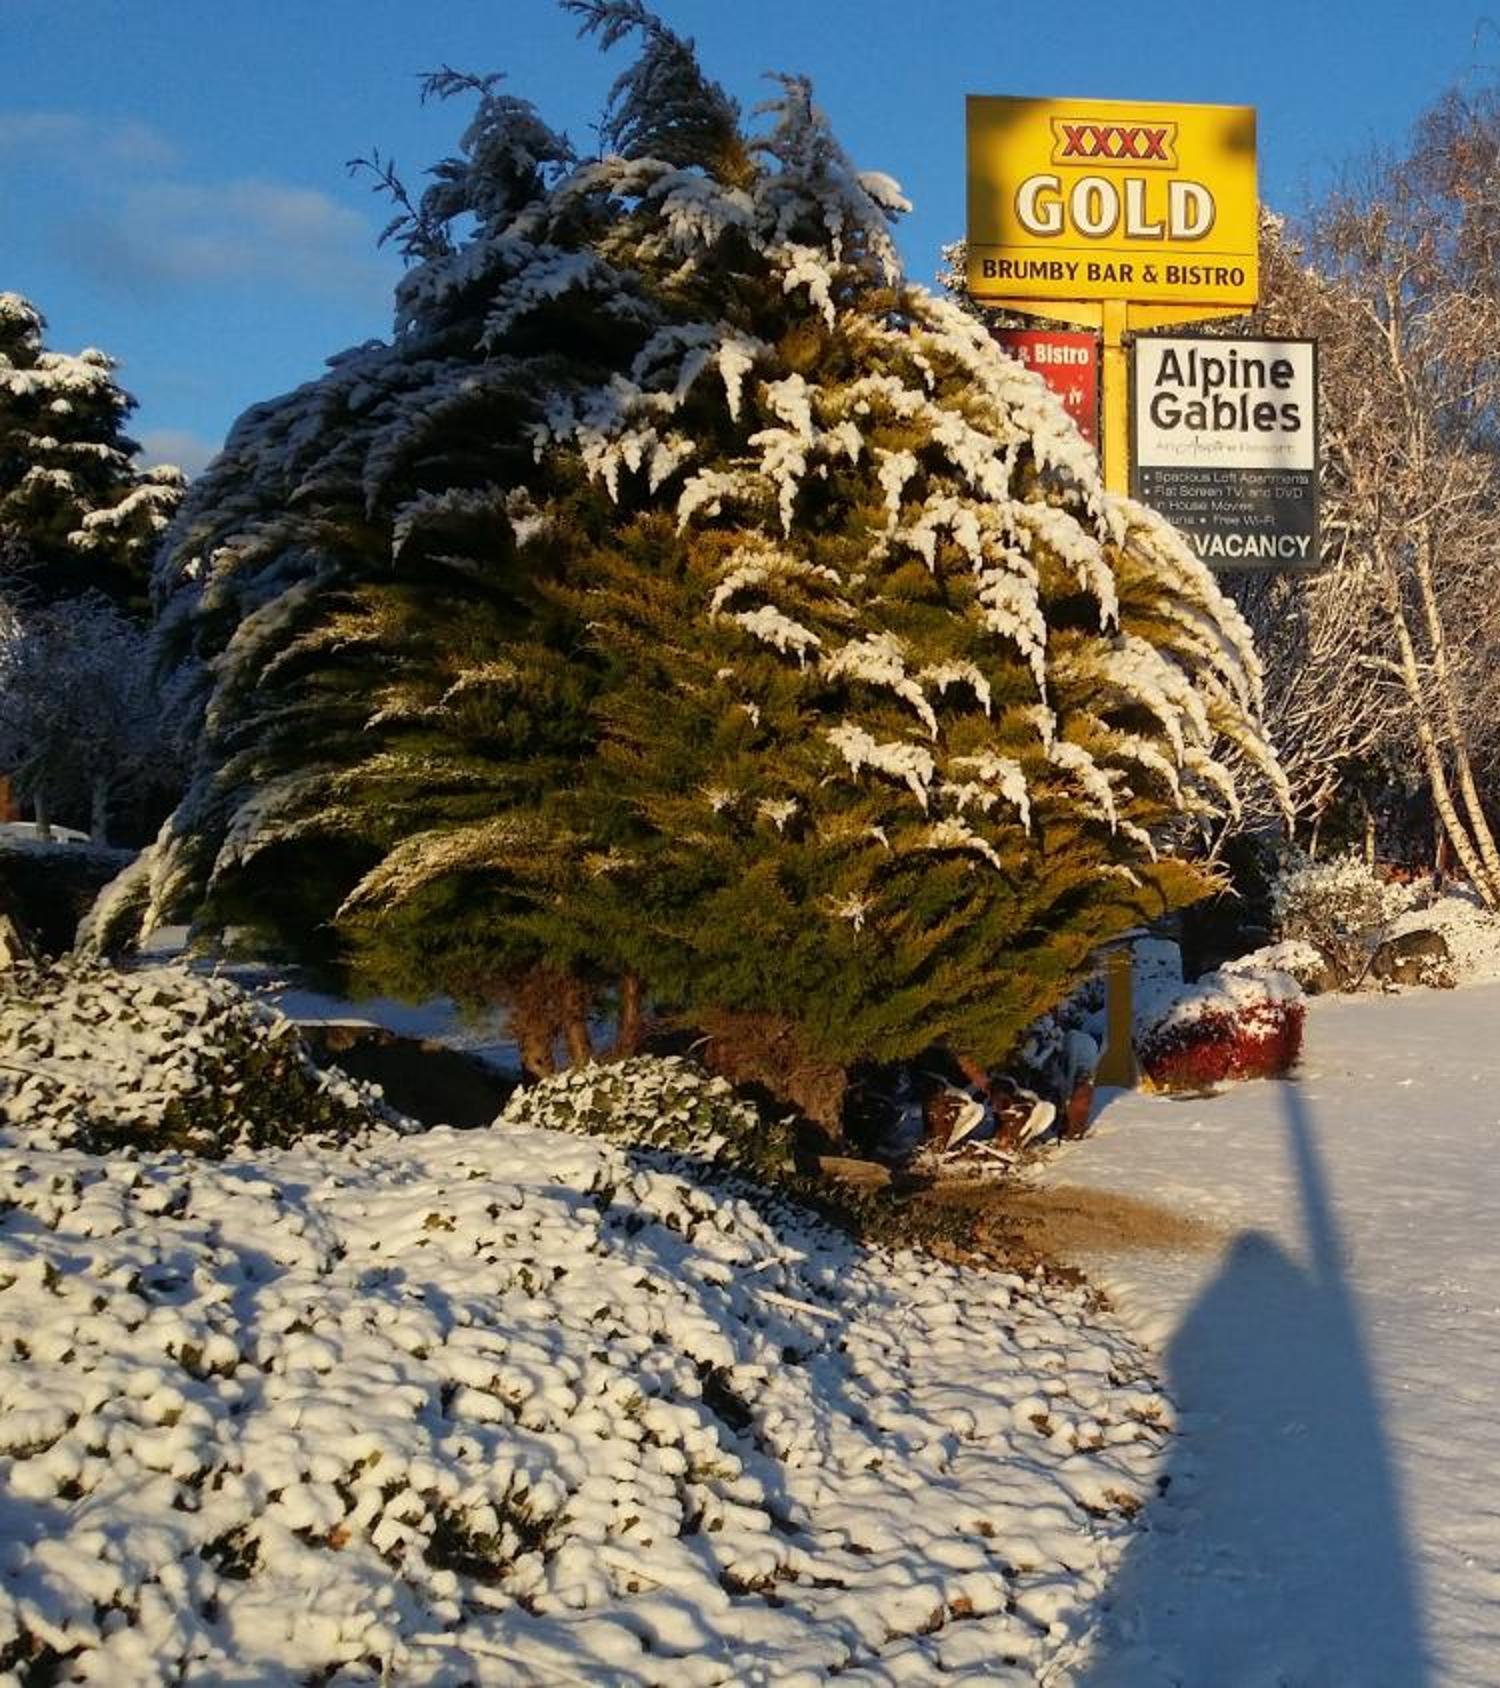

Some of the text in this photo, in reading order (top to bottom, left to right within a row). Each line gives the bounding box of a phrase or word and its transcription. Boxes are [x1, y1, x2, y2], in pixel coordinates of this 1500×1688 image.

[1061, 125, 1168, 160] XXXX
[1015, 174, 1216, 241] GOLD
[983, 259, 1245, 286] BRUMBY BAR & BISTRO
[1034, 343, 1089, 365] Bistro
[1154, 348, 1295, 397] Alpine
[1150, 391, 1301, 433] Gables
[1213, 472, 1237, 483] Loft
[1155, 486, 1177, 497] Flat
[1179, 486, 1223, 497] Screen
[1249, 486, 1271, 498] and
[1275, 487, 1303, 498] DVD
[1170, 501, 1207, 511] House
[1194, 533, 1311, 558] VACANCY
